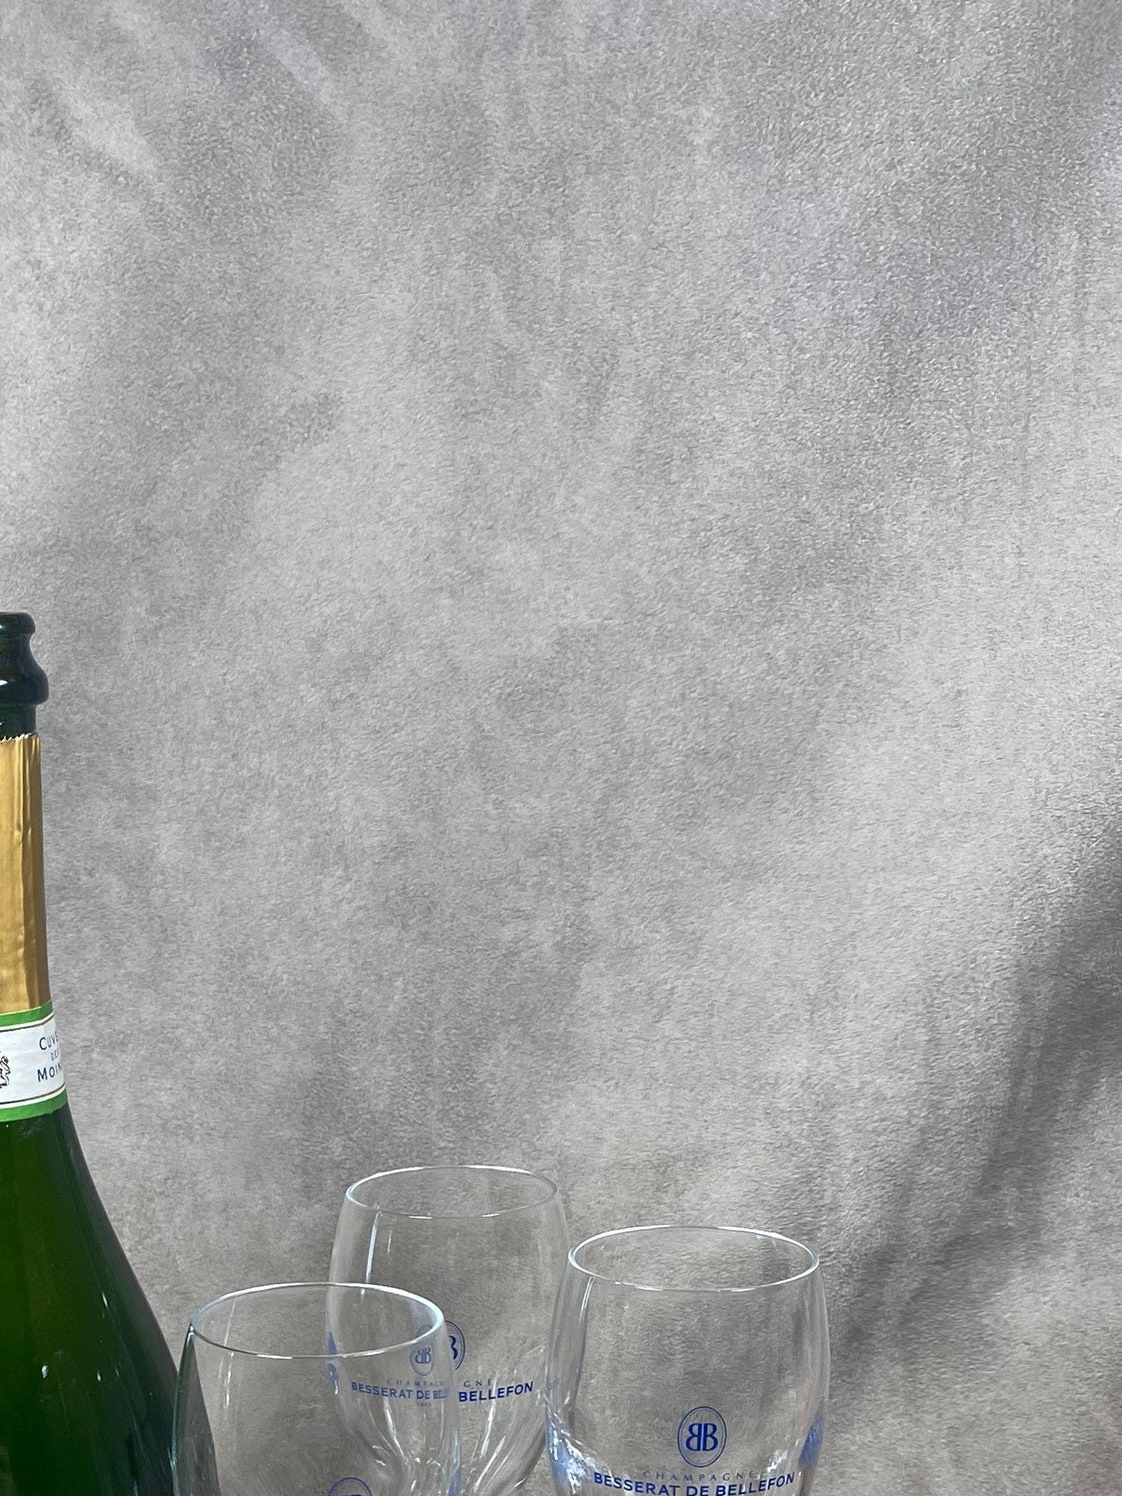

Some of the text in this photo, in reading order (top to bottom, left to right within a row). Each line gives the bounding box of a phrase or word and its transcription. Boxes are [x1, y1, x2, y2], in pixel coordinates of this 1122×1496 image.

[351, 1381, 413, 1400] BESSERAT
[416, 1390, 430, 1400] DE
[458, 1381, 534, 1402] BELLEFON
[715, 1471, 795, 1496] BELLEFON
